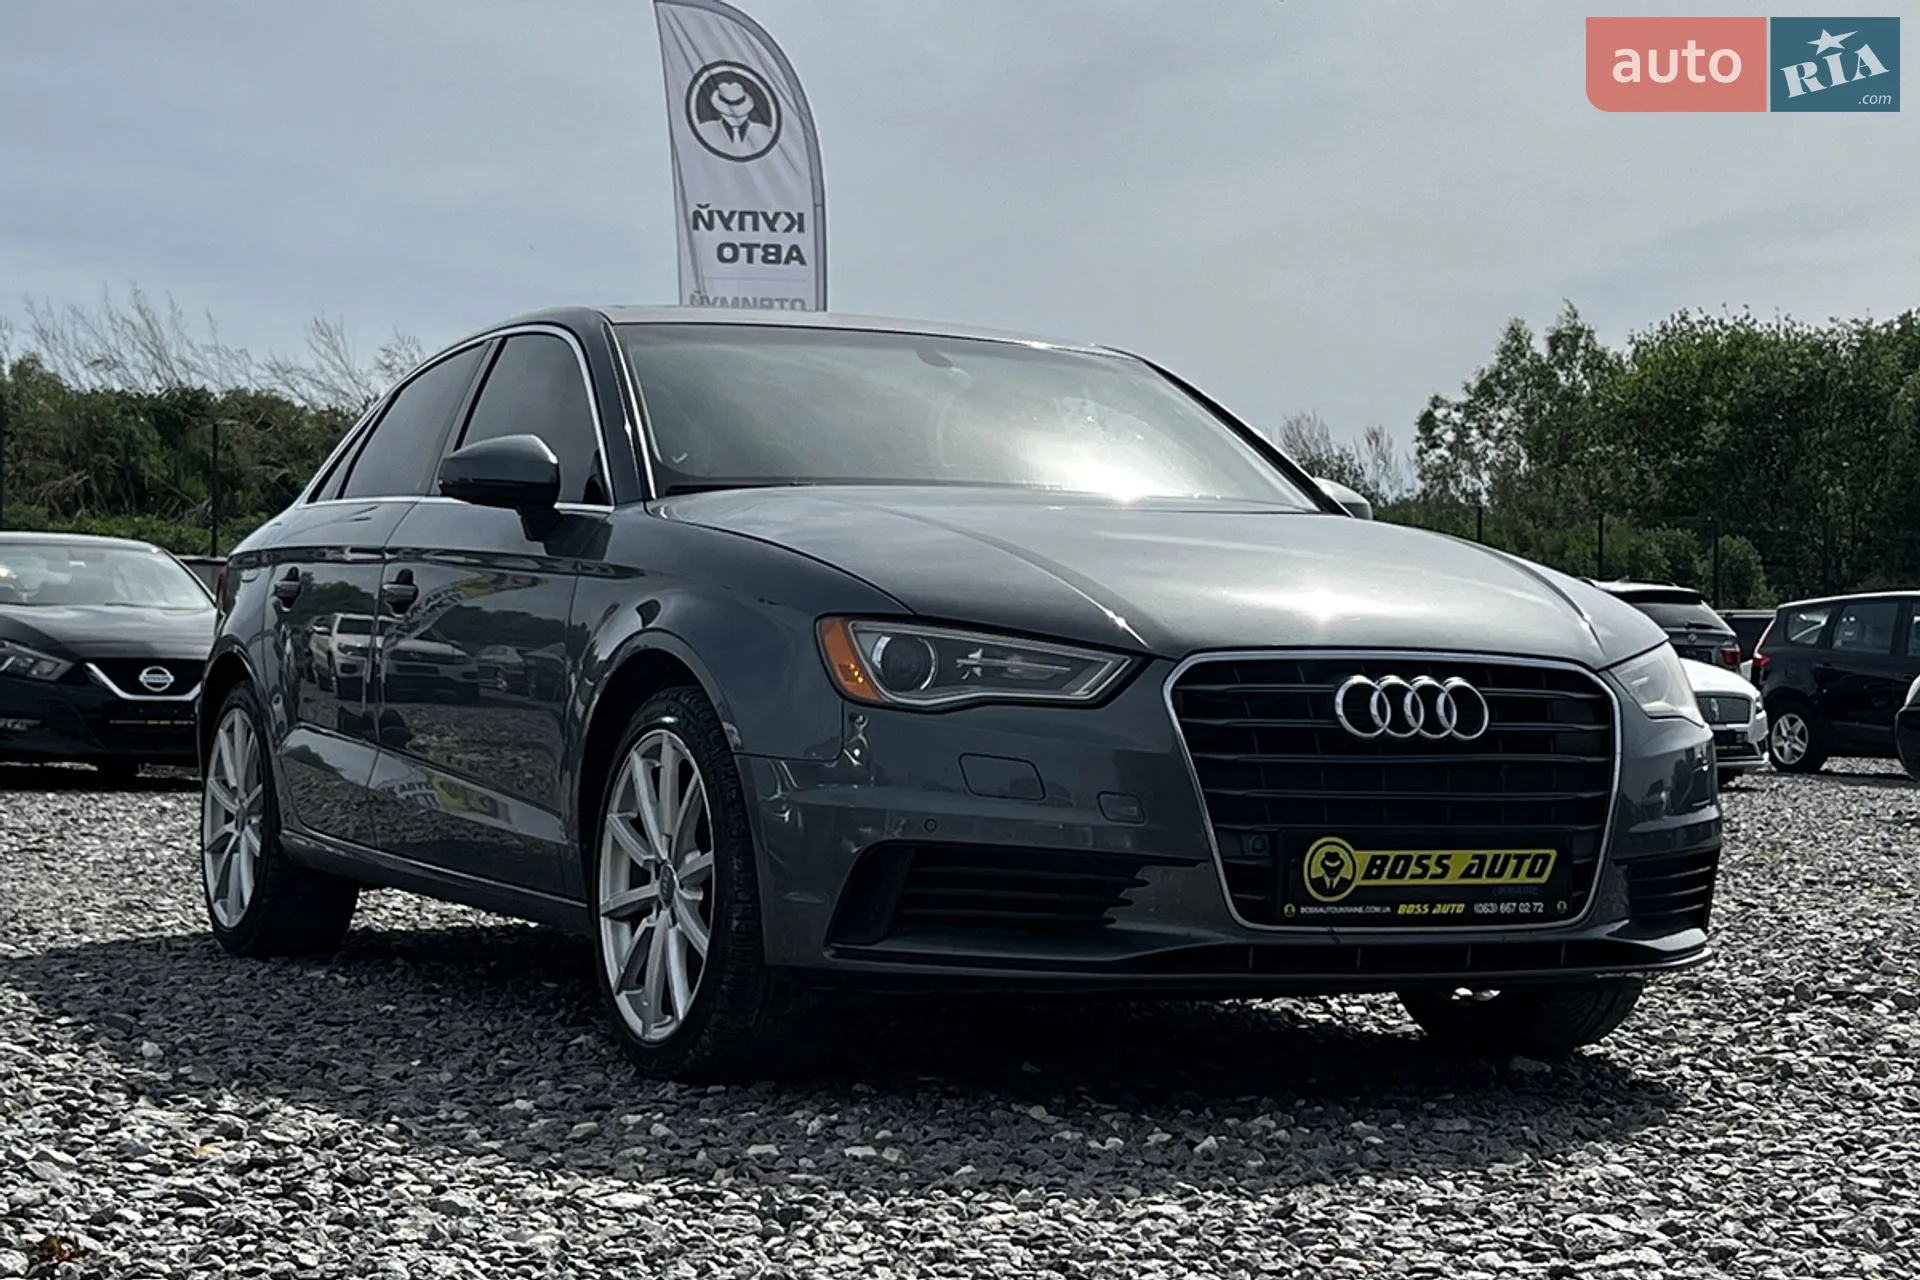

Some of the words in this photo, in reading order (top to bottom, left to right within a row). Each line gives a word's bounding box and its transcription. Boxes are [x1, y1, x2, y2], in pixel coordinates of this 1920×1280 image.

[1361, 854, 1452, 880] BOSS
[1458, 853, 1552, 879] AUTO
[1397, 904, 1429, 915] BOSS
[1431, 903, 1465, 915] AUTO
[1473, 902, 1498, 914] (063)
[1499, 902, 1517, 914] 667
[1518, 902, 1531, 914] 02
[1532, 901, 1545, 914] 72
